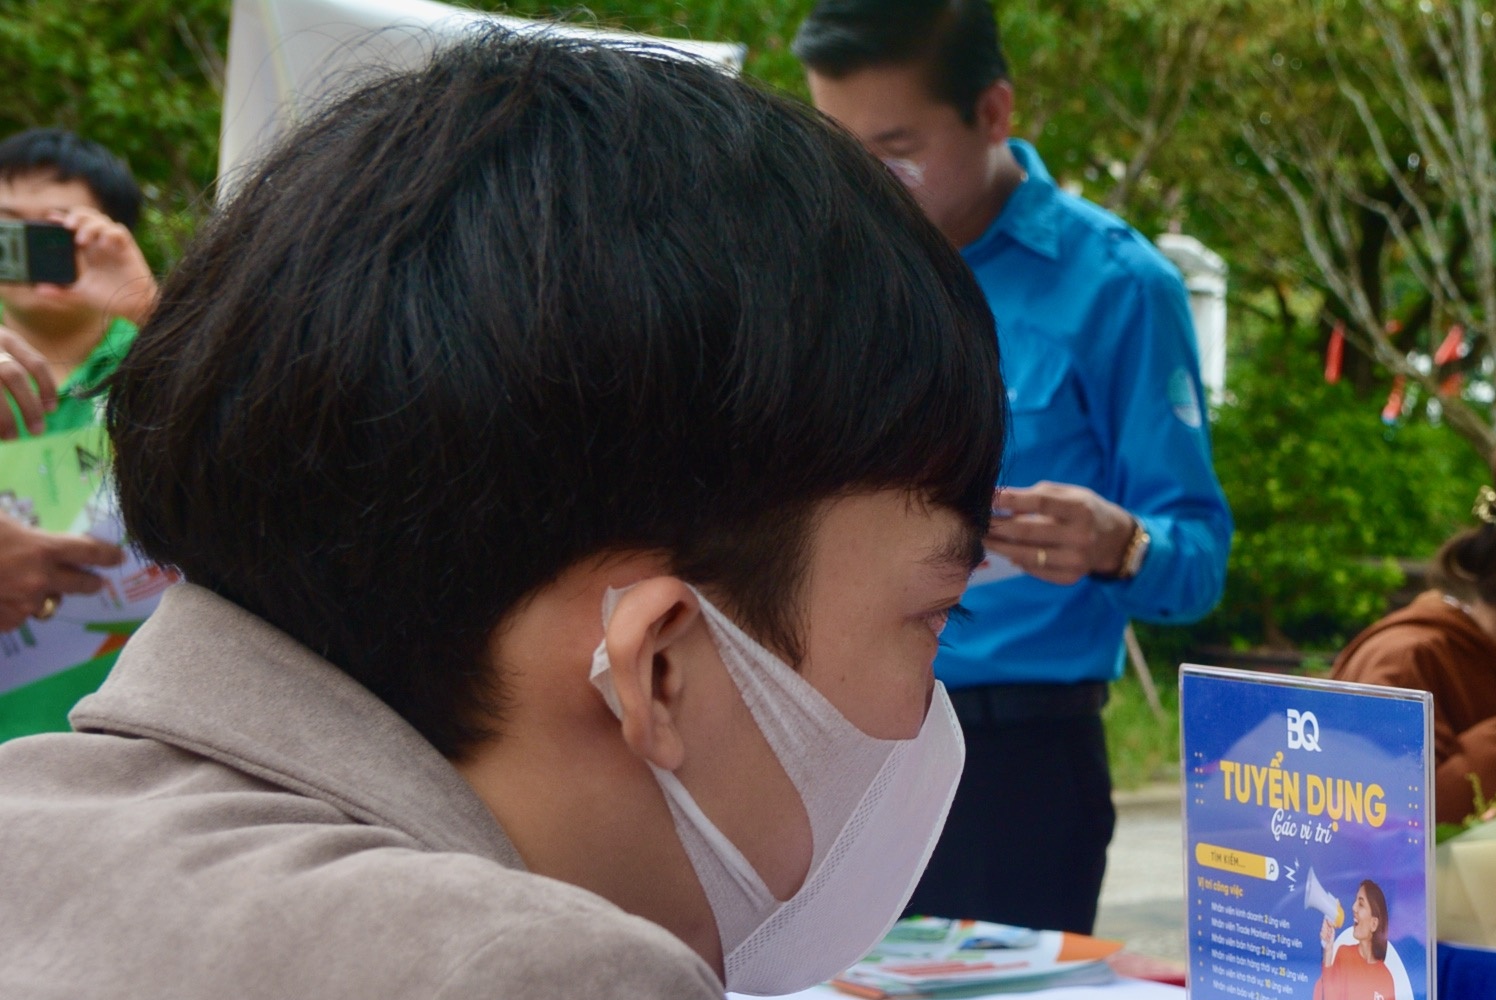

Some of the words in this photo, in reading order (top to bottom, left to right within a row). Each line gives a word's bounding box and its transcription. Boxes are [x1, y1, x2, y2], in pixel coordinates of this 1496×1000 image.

[1286, 708, 1322, 752] BQ
[1219, 751, 1300, 812] TUYỂN
[1306, 774, 1387, 832] DỤNG
[1271, 808, 1297, 842] Các
[1299, 819, 1312, 845] vị
[1314, 822, 1333, 844] trí
[1211, 850, 1222, 862] TÌM
[1213, 879, 1228, 895] công
[1230, 884, 1242, 899] việc
[1211, 902, 1224, 912] Nhân
[1225, 905, 1234, 915] viên
[1236, 908, 1245, 917] kinh
[1280, 918, 1290, 928] viên
[1211, 918, 1224, 928] Nhân
[1225, 921, 1234, 931] viên
[1236, 923, 1249, 934] Trade
[1292, 937, 1302, 948] viên
[1211, 934, 1224, 944] Nhân
[1225, 937, 1234, 947] viên
[1236, 940, 1245, 949] bán
[1276, 950, 1286, 960] viên
[1211, 949, 1224, 959] Nhân
[1226, 953, 1235, 962] viên
[1236, 955, 1246, 965] bán
[1246, 958, 1260, 971] hàng
[1297, 972, 1308, 982] viên
[1212, 965, 1224, 975] Nhân
[1226, 968, 1235, 978] viên
[1236, 971, 1246, 981] kho
[1282, 984, 1292, 994] viên
[1212, 980, 1224, 990] Nhân
[1226, 983, 1236, 994] viên
